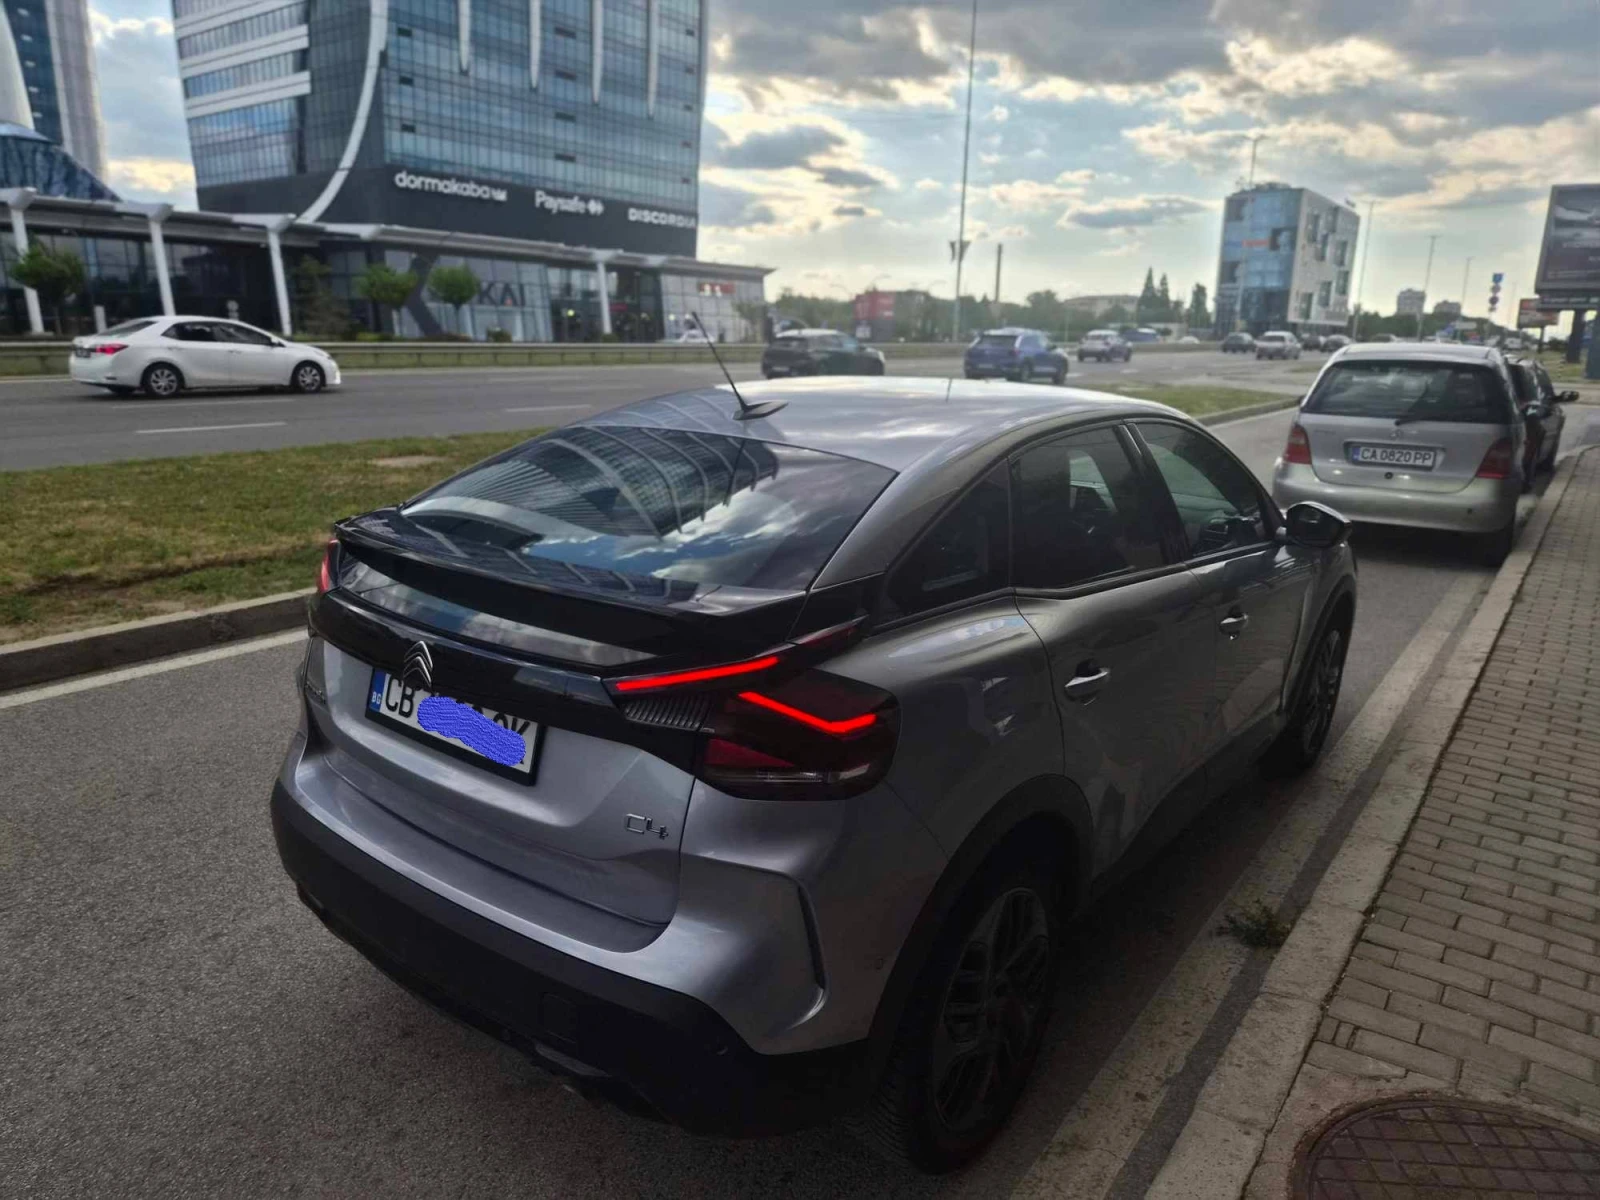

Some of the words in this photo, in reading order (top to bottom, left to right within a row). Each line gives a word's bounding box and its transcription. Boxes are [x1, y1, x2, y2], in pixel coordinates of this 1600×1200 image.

[394, 170, 490, 199] dormakaba
[535, 190, 586, 214] Paysafe
[628, 207, 697, 228] DISCORDIA
[1361, 448, 1378, 460] CA
[1380, 449, 1412, 463] 0820
[1413, 451, 1432, 464] PP
[371, 690, 382, 705] BG
[626, 813, 669, 840] C4
